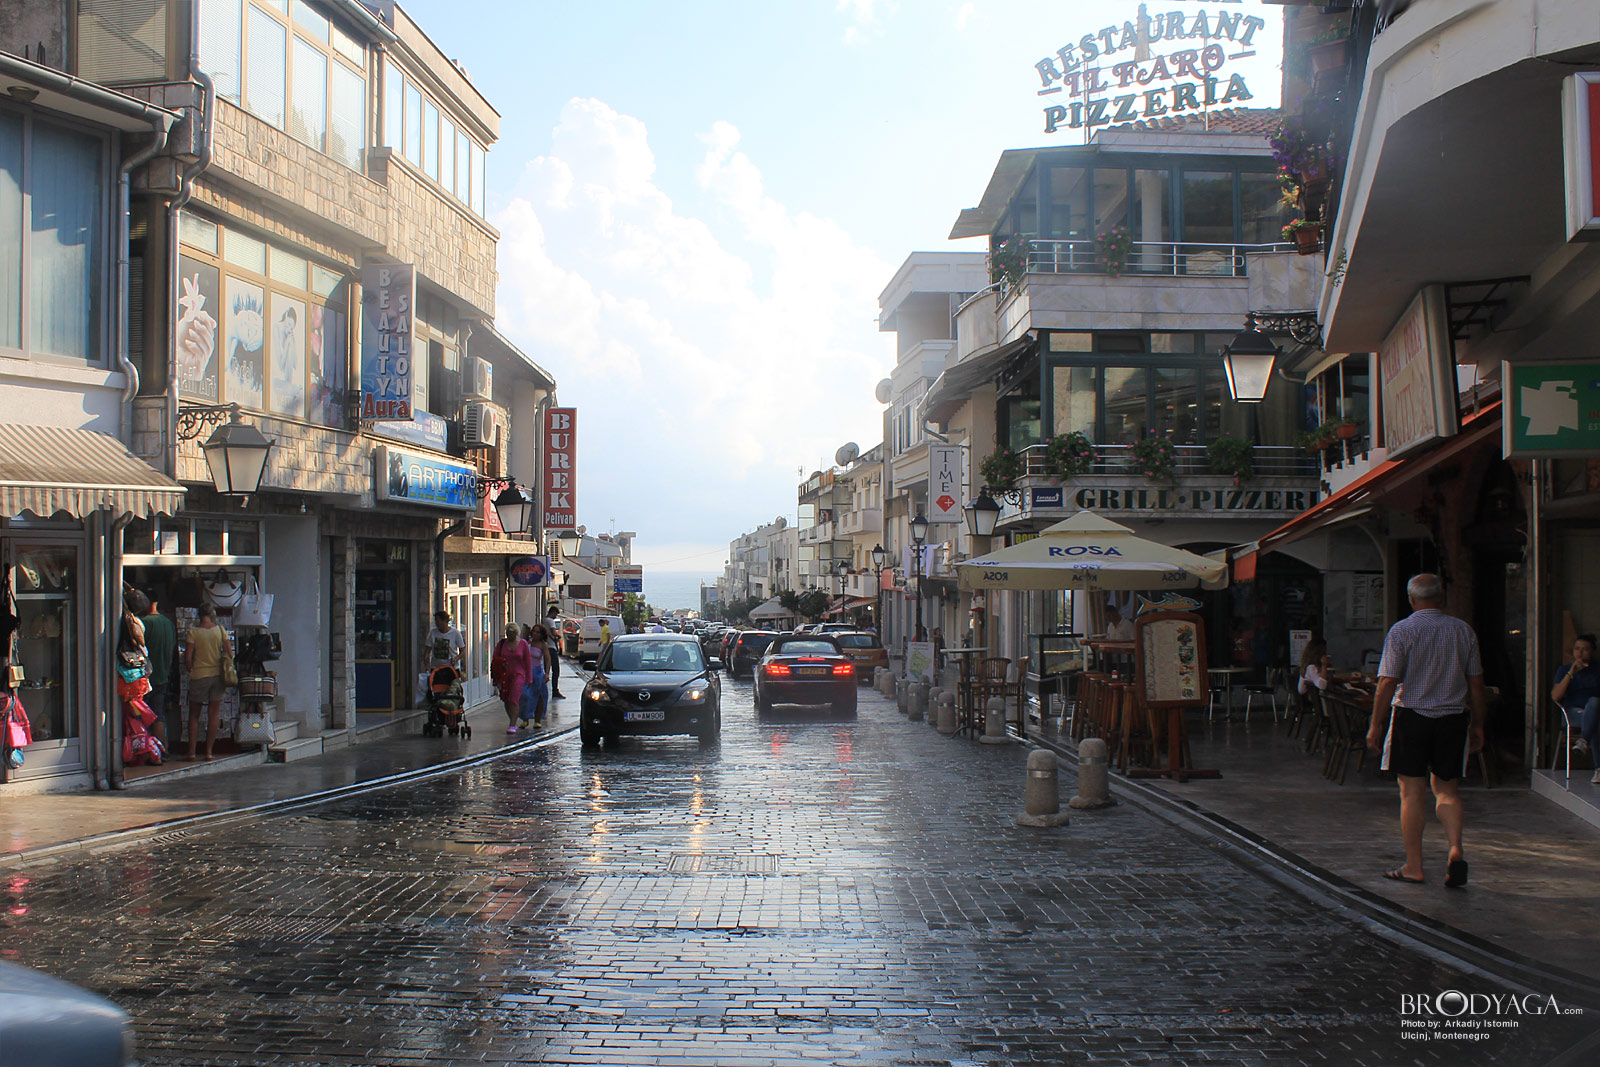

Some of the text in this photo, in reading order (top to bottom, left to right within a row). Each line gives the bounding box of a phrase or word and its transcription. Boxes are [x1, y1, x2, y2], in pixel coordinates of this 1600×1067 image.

[1034, 9, 1265, 87] RESTAURANT
[1063, 43, 1225, 98] IL FARO
[1044, 73, 1253, 133] PIZZERIA
[376, 269, 391, 397] BEAUTY
[396, 294, 409, 397] SALON
[363, 392, 409, 417] Aura
[549, 413, 571, 508] BUREK
[937, 450, 954, 492] TIME
[545, 512, 573, 525] Pelivan
[1075, 488, 1175, 510] GRILL
[391, 545, 408, 560] ART
[1048, 546, 1123, 557] ROSA
